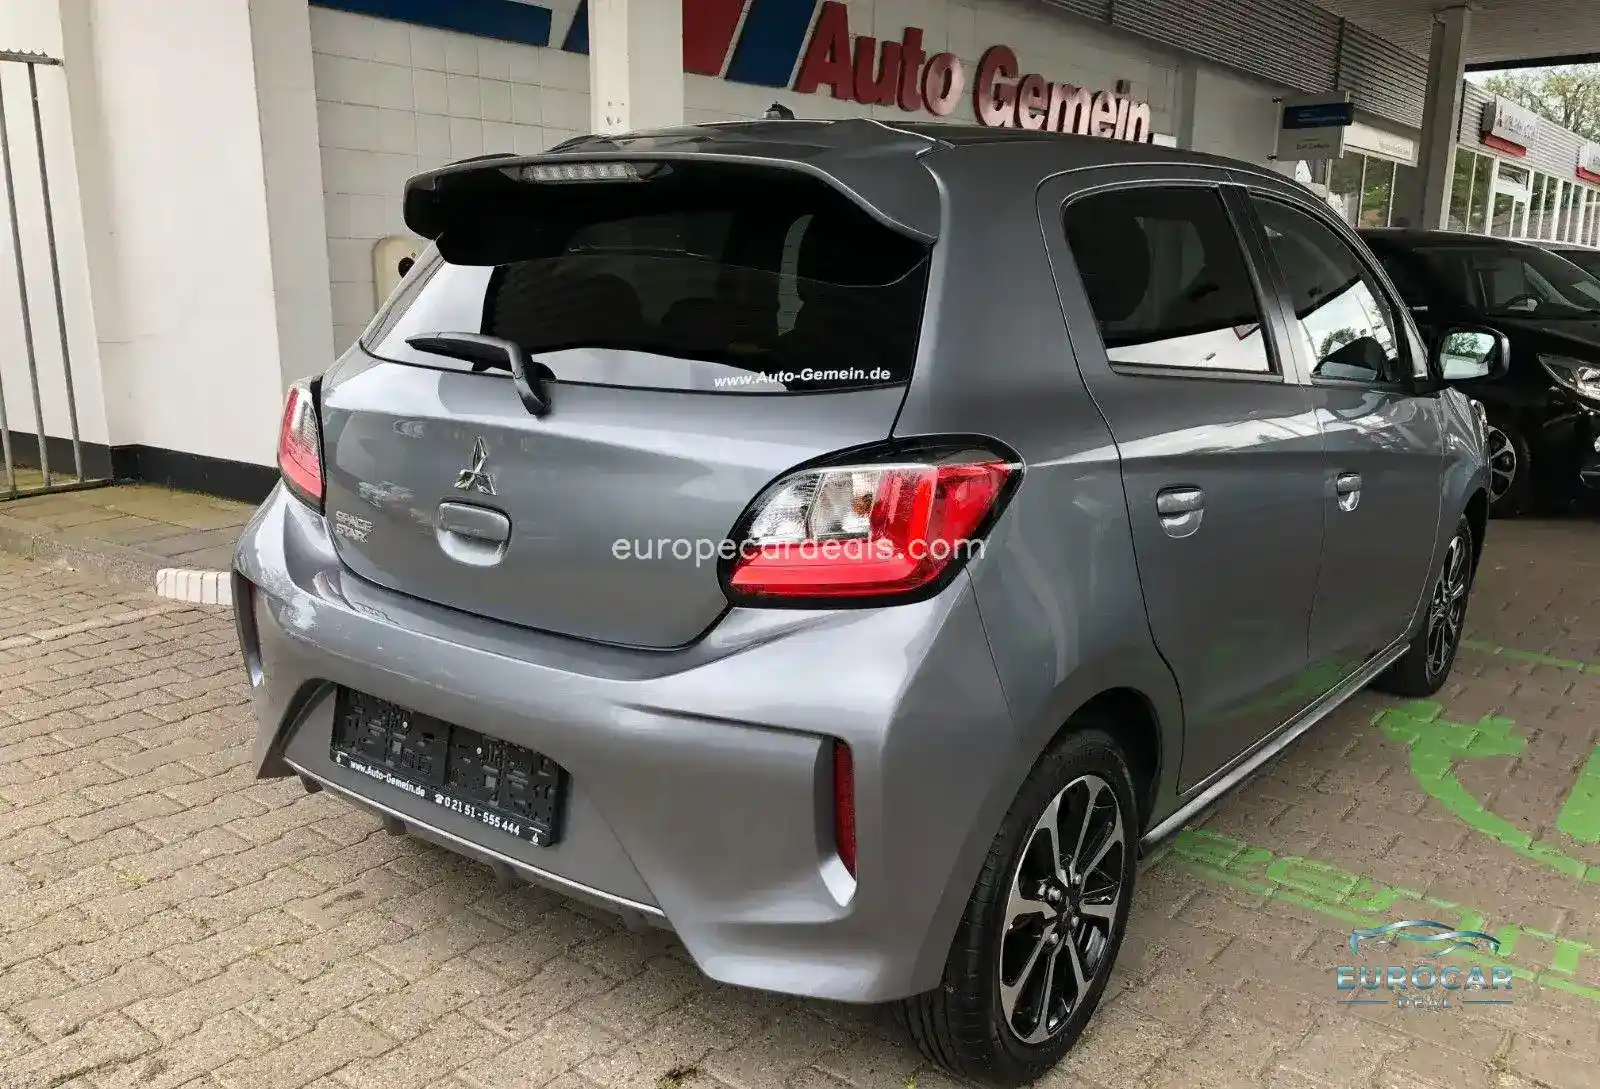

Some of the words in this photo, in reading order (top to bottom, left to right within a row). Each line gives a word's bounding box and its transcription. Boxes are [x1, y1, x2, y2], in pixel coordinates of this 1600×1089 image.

[792, 1, 965, 116] Auto
[974, 44, 1152, 143] Gemein
[714, 366, 892, 388] www.Auto-Gemein.de
[350, 760, 426, 797] www.Auto-Gemein.de
